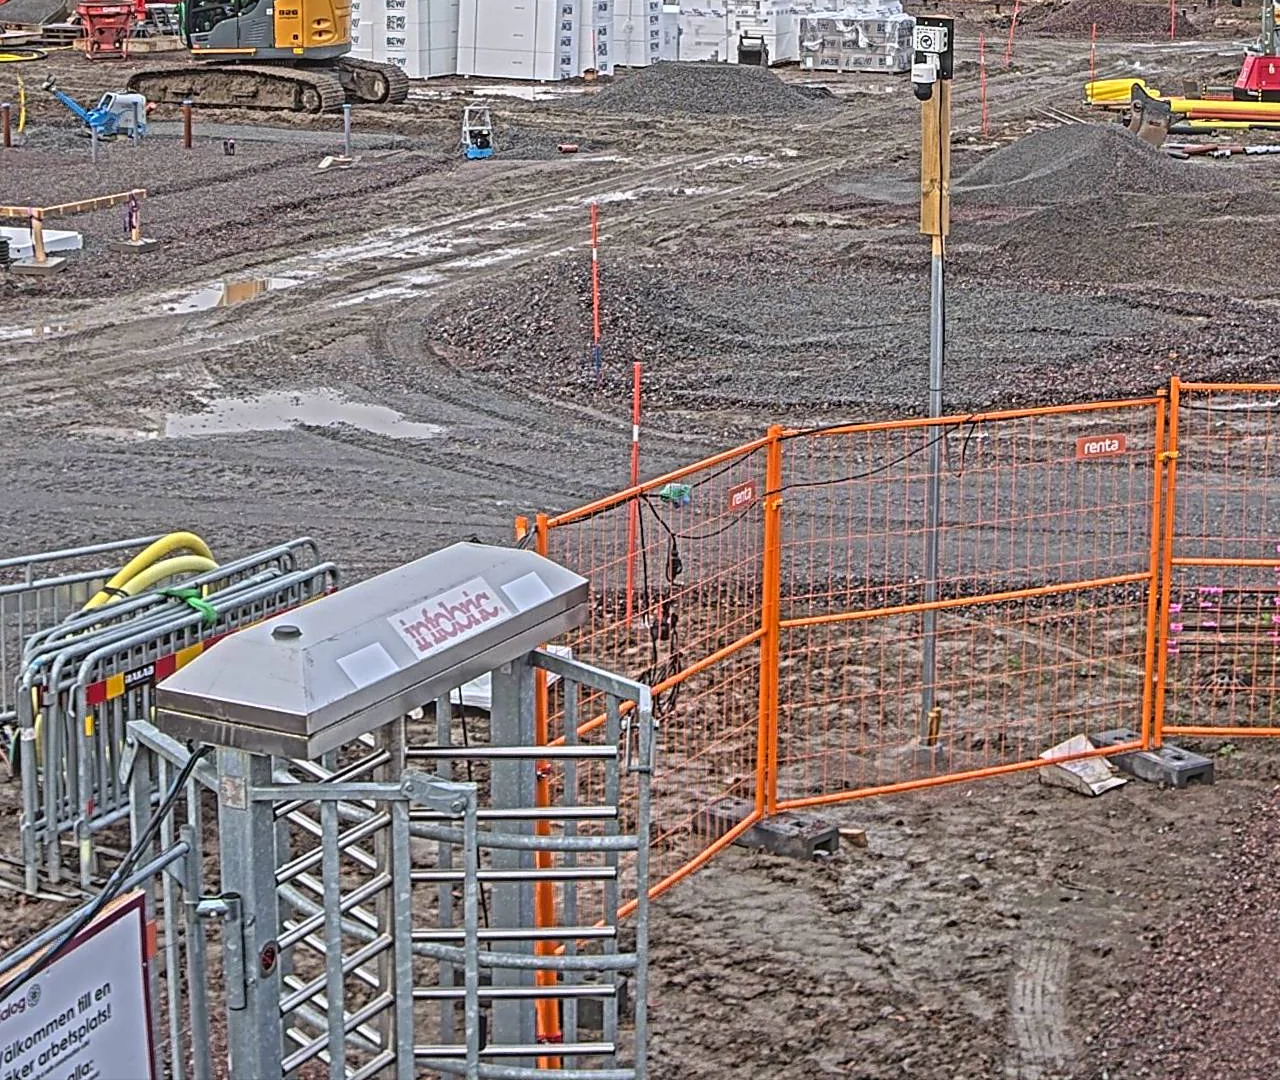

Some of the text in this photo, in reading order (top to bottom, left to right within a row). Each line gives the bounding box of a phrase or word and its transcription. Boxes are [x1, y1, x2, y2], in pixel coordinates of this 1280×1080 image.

[1082, 438, 1119, 455] renta
[399, 590, 499, 652] infobric
[77, 991, 91, 1014] till
[94, 982, 111, 1001] en
[4, 1059, 35, 1080] äker
[37, 1003, 111, 1066] arbetsplats!
